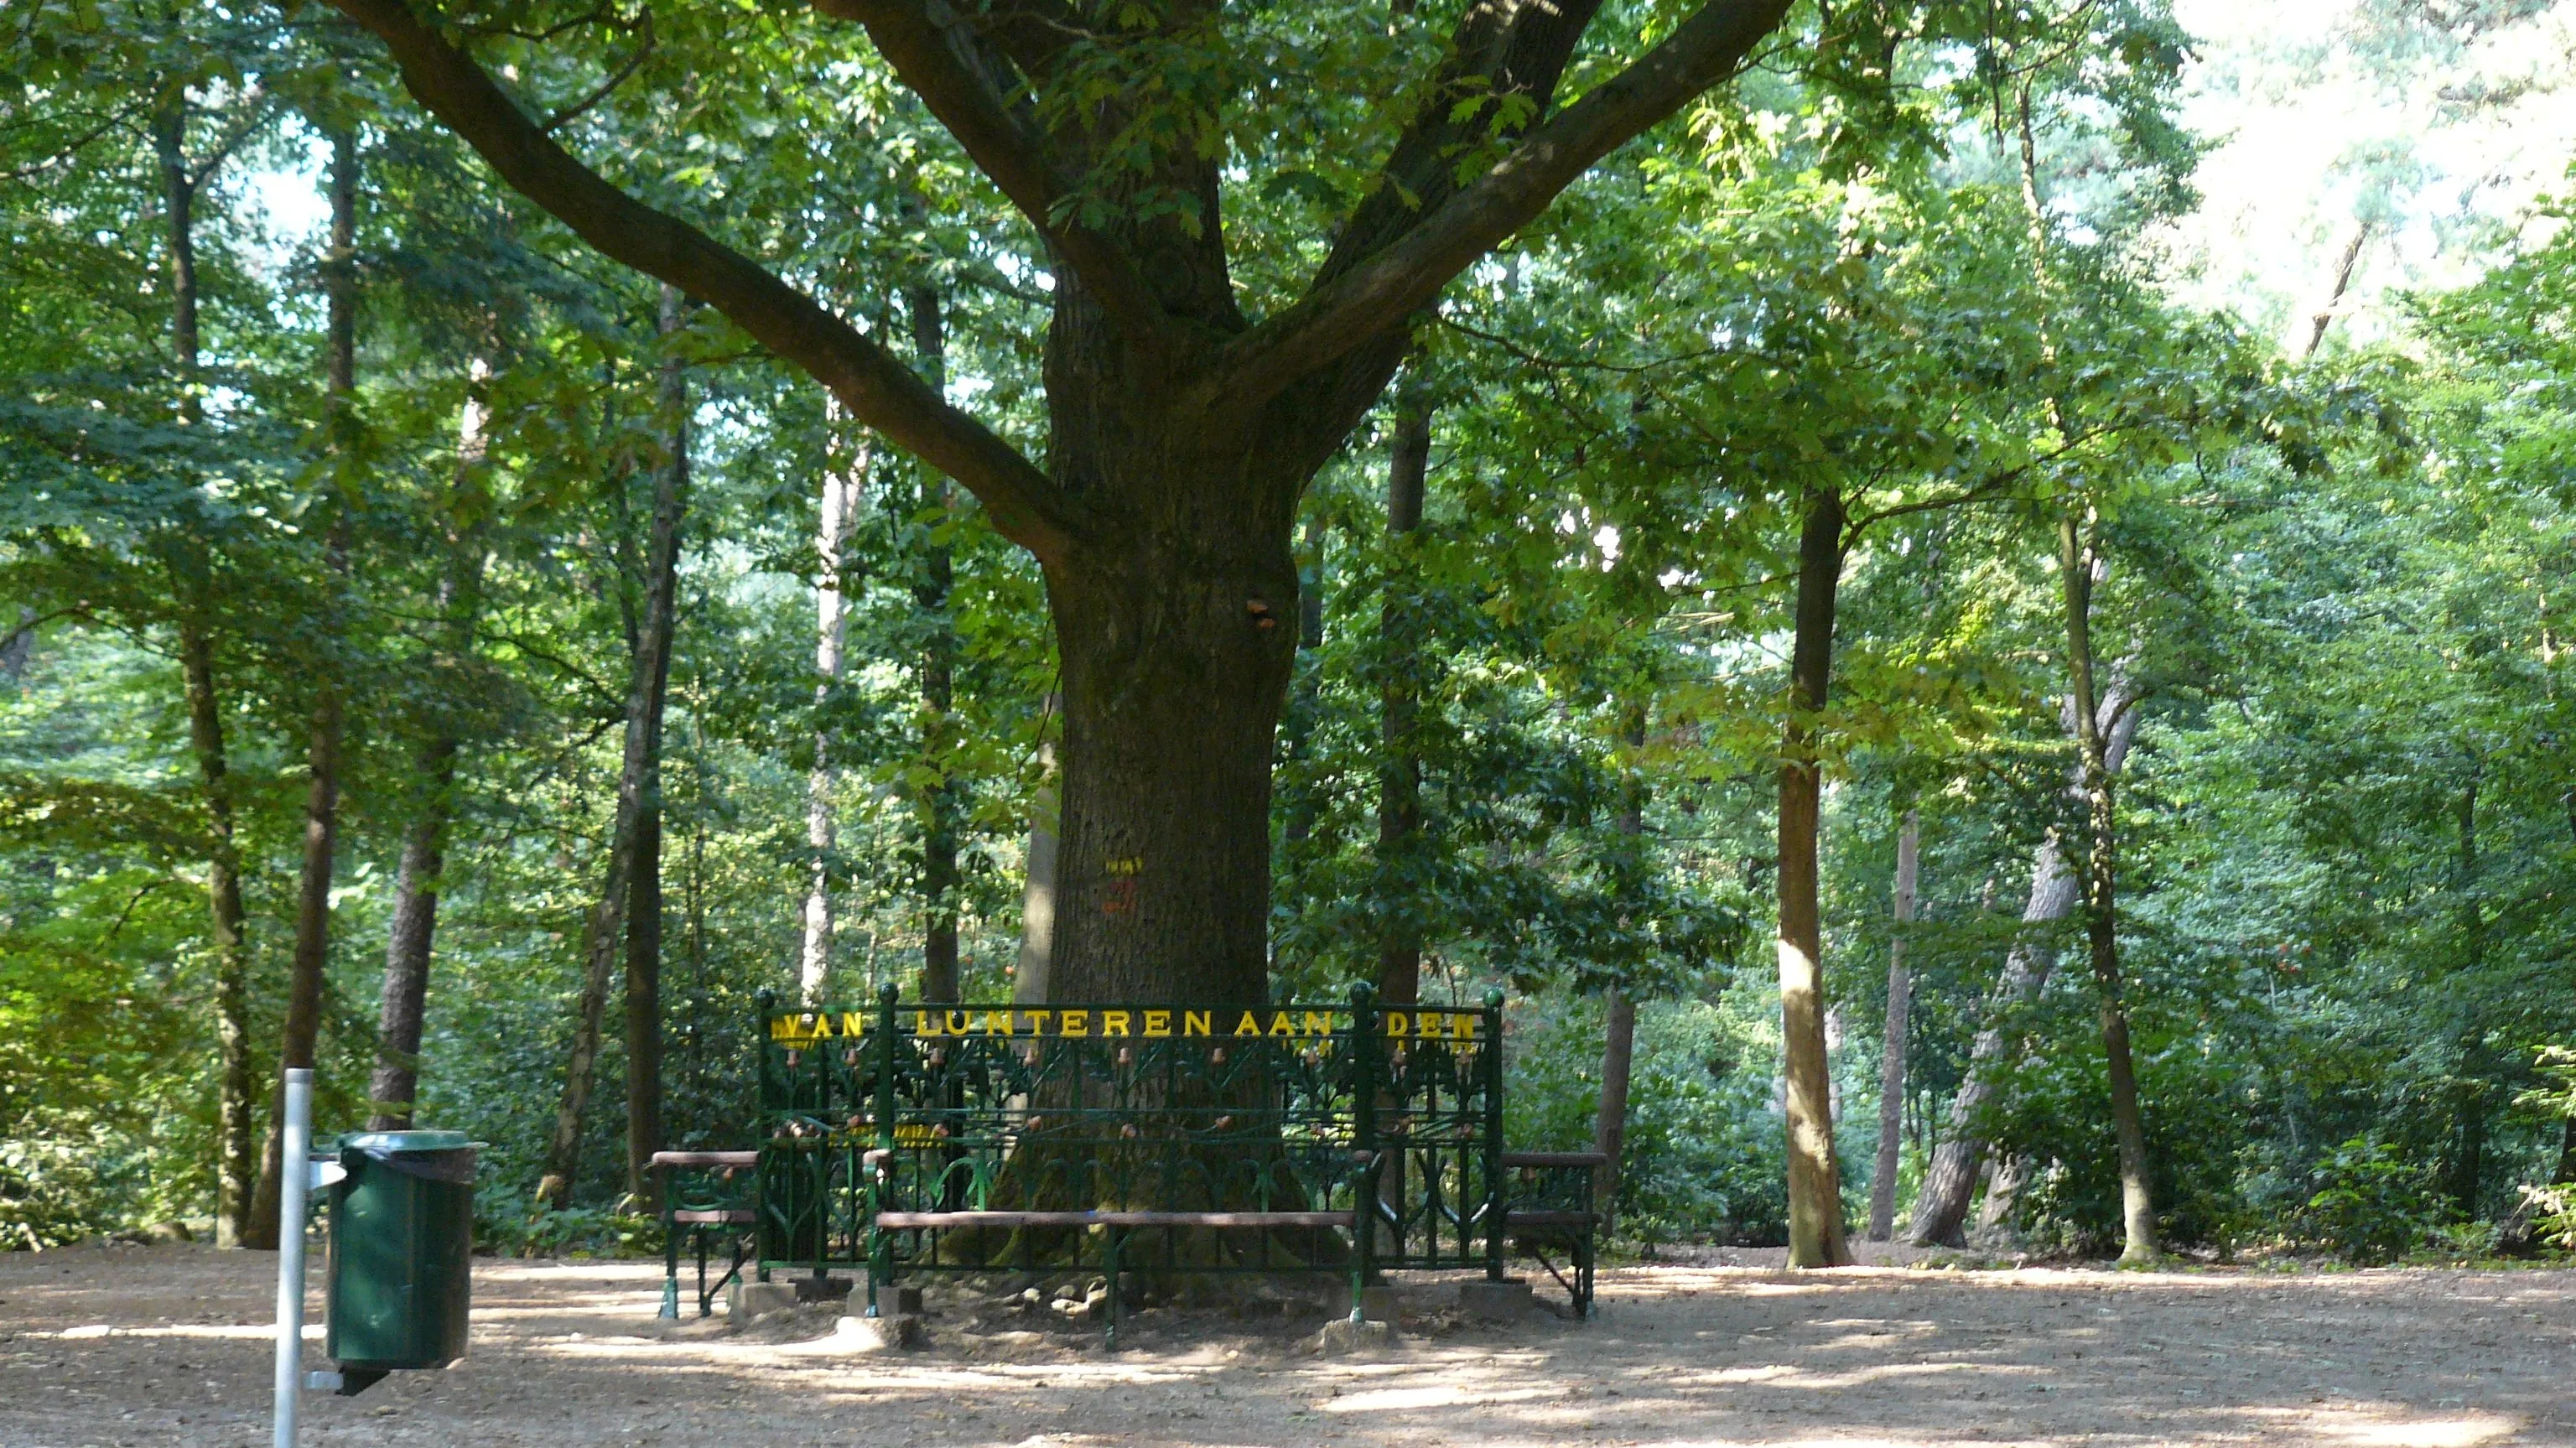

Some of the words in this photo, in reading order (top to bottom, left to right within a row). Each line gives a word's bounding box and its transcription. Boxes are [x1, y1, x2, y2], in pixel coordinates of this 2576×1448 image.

[784, 1011, 864, 1038] VAN
[916, 1009, 1213, 1040] LUNTEREN
[1233, 1009, 1333, 1038] AAN
[1386, 1010, 1475, 1040] DEN
